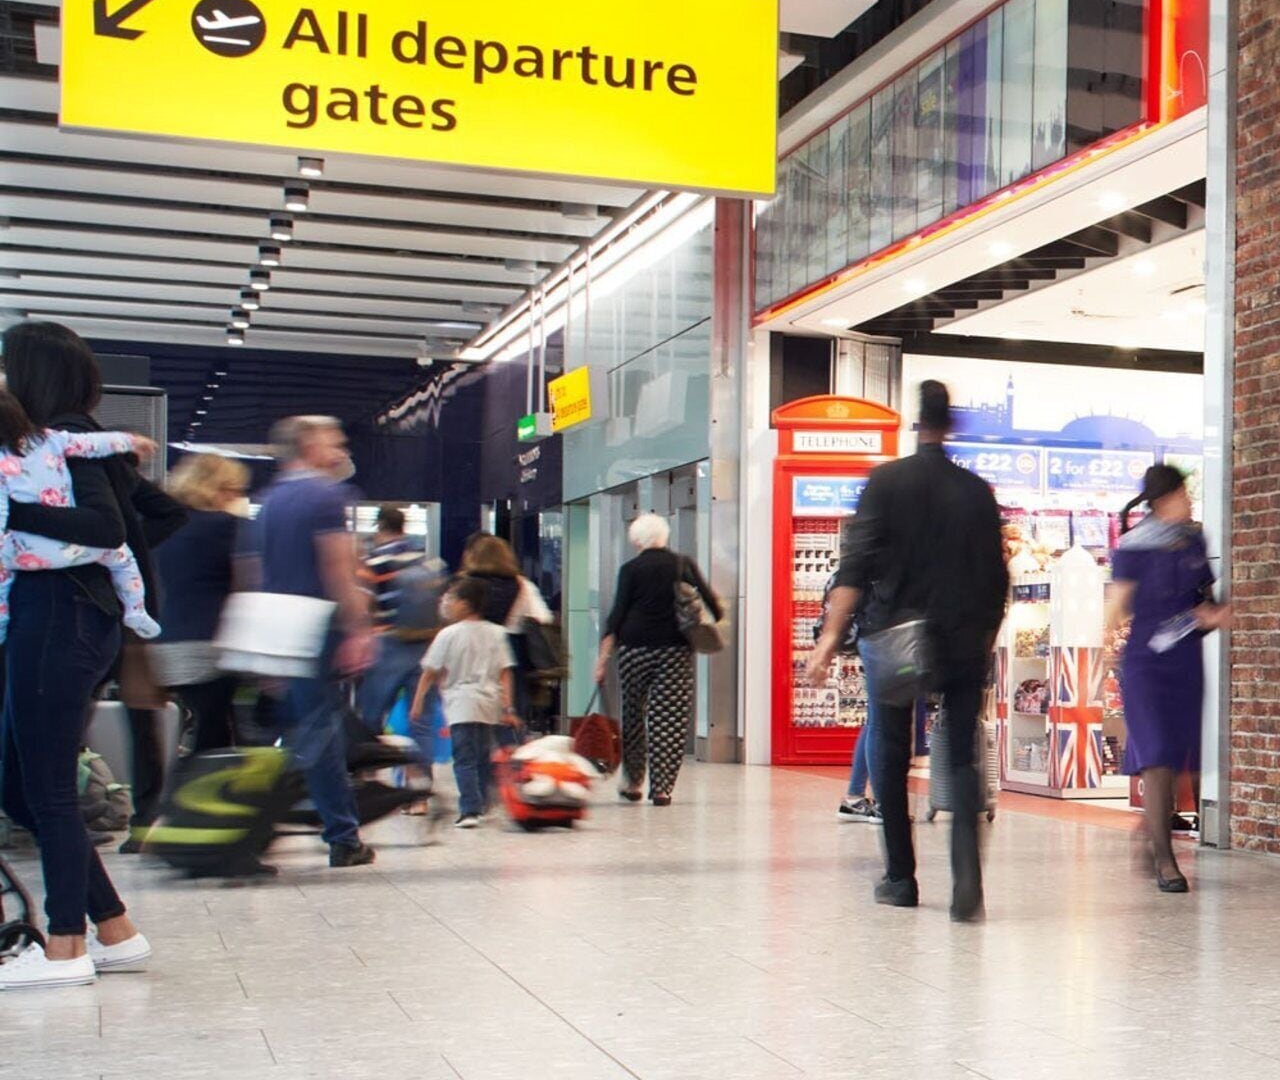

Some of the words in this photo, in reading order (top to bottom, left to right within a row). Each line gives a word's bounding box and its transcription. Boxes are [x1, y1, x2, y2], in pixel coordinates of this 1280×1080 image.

[282, 6, 369, 59] All
[391, 19, 699, 96] departure
[281, 80, 458, 131] gates
[800, 434, 877, 448] TELEPHONE
[952, 454, 972, 470] for
[975, 452, 1013, 471] £22
[1050, 457, 1062, 474] 2
[1065, 459, 1085, 475] for
[1088, 459, 1124, 477] £22
